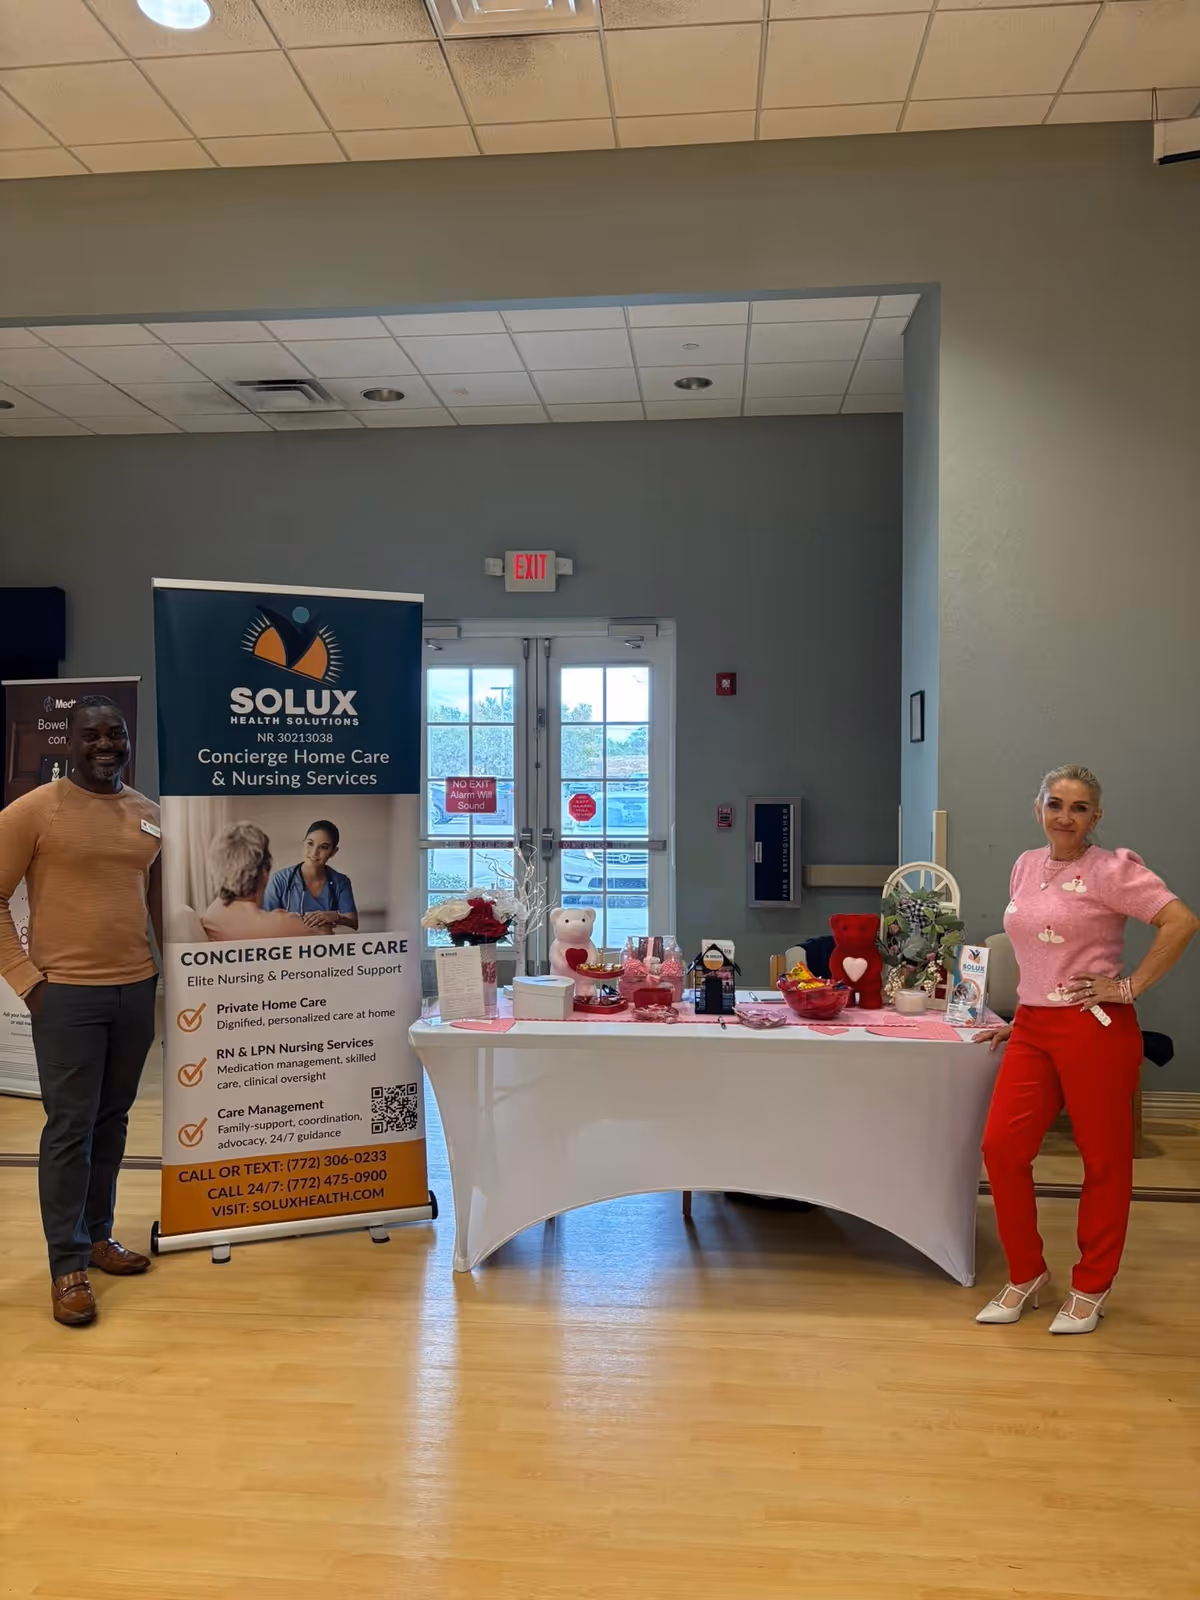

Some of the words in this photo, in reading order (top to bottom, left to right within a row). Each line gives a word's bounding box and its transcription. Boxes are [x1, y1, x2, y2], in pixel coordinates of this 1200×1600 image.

[514, 553, 547, 580] EXIT
[230, 686, 358, 716] SOLUX
[38, 717, 68, 730] Bowel
[230, 716, 280, 725] HEALTH
[286, 716, 359, 726] SOLUTIONS
[257, 732, 275, 743] NR
[277, 732, 333, 743] 30213038
[197, 748, 288, 767] Concierge
[294, 749, 346, 764] Home
[350, 749, 389, 764] Care
[211, 771, 226, 786] &
[232, 770, 301, 789] Nursing
[306, 770, 377, 786] Services
[452, 780, 467, 789] NO
[469, 780, 490, 789] EXIT
[450, 790, 475, 799] Alarm
[476, 790, 493, 799] Will
[457, 801, 485, 810] Sound
[180, 945, 293, 967] CONCIERGE
[298, 941, 357, 960] HOME
[361, 939, 409, 955] CARE
[187, 974, 214, 988] Elite
[217, 971, 265, 987] Nursing
[267, 970, 277, 982] &
[280, 965, 354, 981] Personalized
[356, 963, 403, 979] Support
[962, 963, 985, 972] SOLUX
[216, 1001, 259, 1015] Private
[261, 998, 297, 1011] Home
[300, 997, 327, 1009] Care
[216, 1017, 265, 1031] Dignified,
[267, 1012, 331, 1028] personalized
[333, 1011, 354, 1021] care
[356, 1010, 366, 1019] at
[368, 1007, 396, 1018] home
[216, 1048, 235, 1060] RN
[238, 1047, 248, 1058] &
[251, 1044, 276, 1057] LPN
[279, 1041, 324, 1055] Nursing
[326, 1037, 374, 1050] Services
[217, 1062, 274, 1075] Medication
[276, 1055, 344, 1071] management,
[345, 1052, 376, 1064] skilled
[217, 1080, 241, 1091] care,
[243, 1075, 278, 1086] clinical
[280, 1071, 327, 1085] oversight
[217, 1107, 245, 1119] Care
[247, 1099, 325, 1117] Management
[217, 1118, 296, 1135] Family-support,
[298, 1111, 363, 1128] coordination,
[217, 1136, 268, 1151] advocacy,
[269, 1132, 295, 1146] 24/7
[297, 1128, 342, 1143] guidance
[178, 1168, 216, 1184] CALL
[219, 1165, 241, 1179] OR
[243, 1161, 284, 1176] TEXT:
[286, 1156, 320, 1174] (772)
[323, 1149, 388, 1167] 306-0233
[207, 1186, 244, 1201] CALL
[246, 1181, 284, 1197] 24/7:
[286, 1176, 321, 1193] (772)
[323, 1169, 388, 1186] 475-0900
[211, 1202, 250, 1218] VISIT:
[252, 1187, 385, 1214] SOLUXHEALTH.COM
